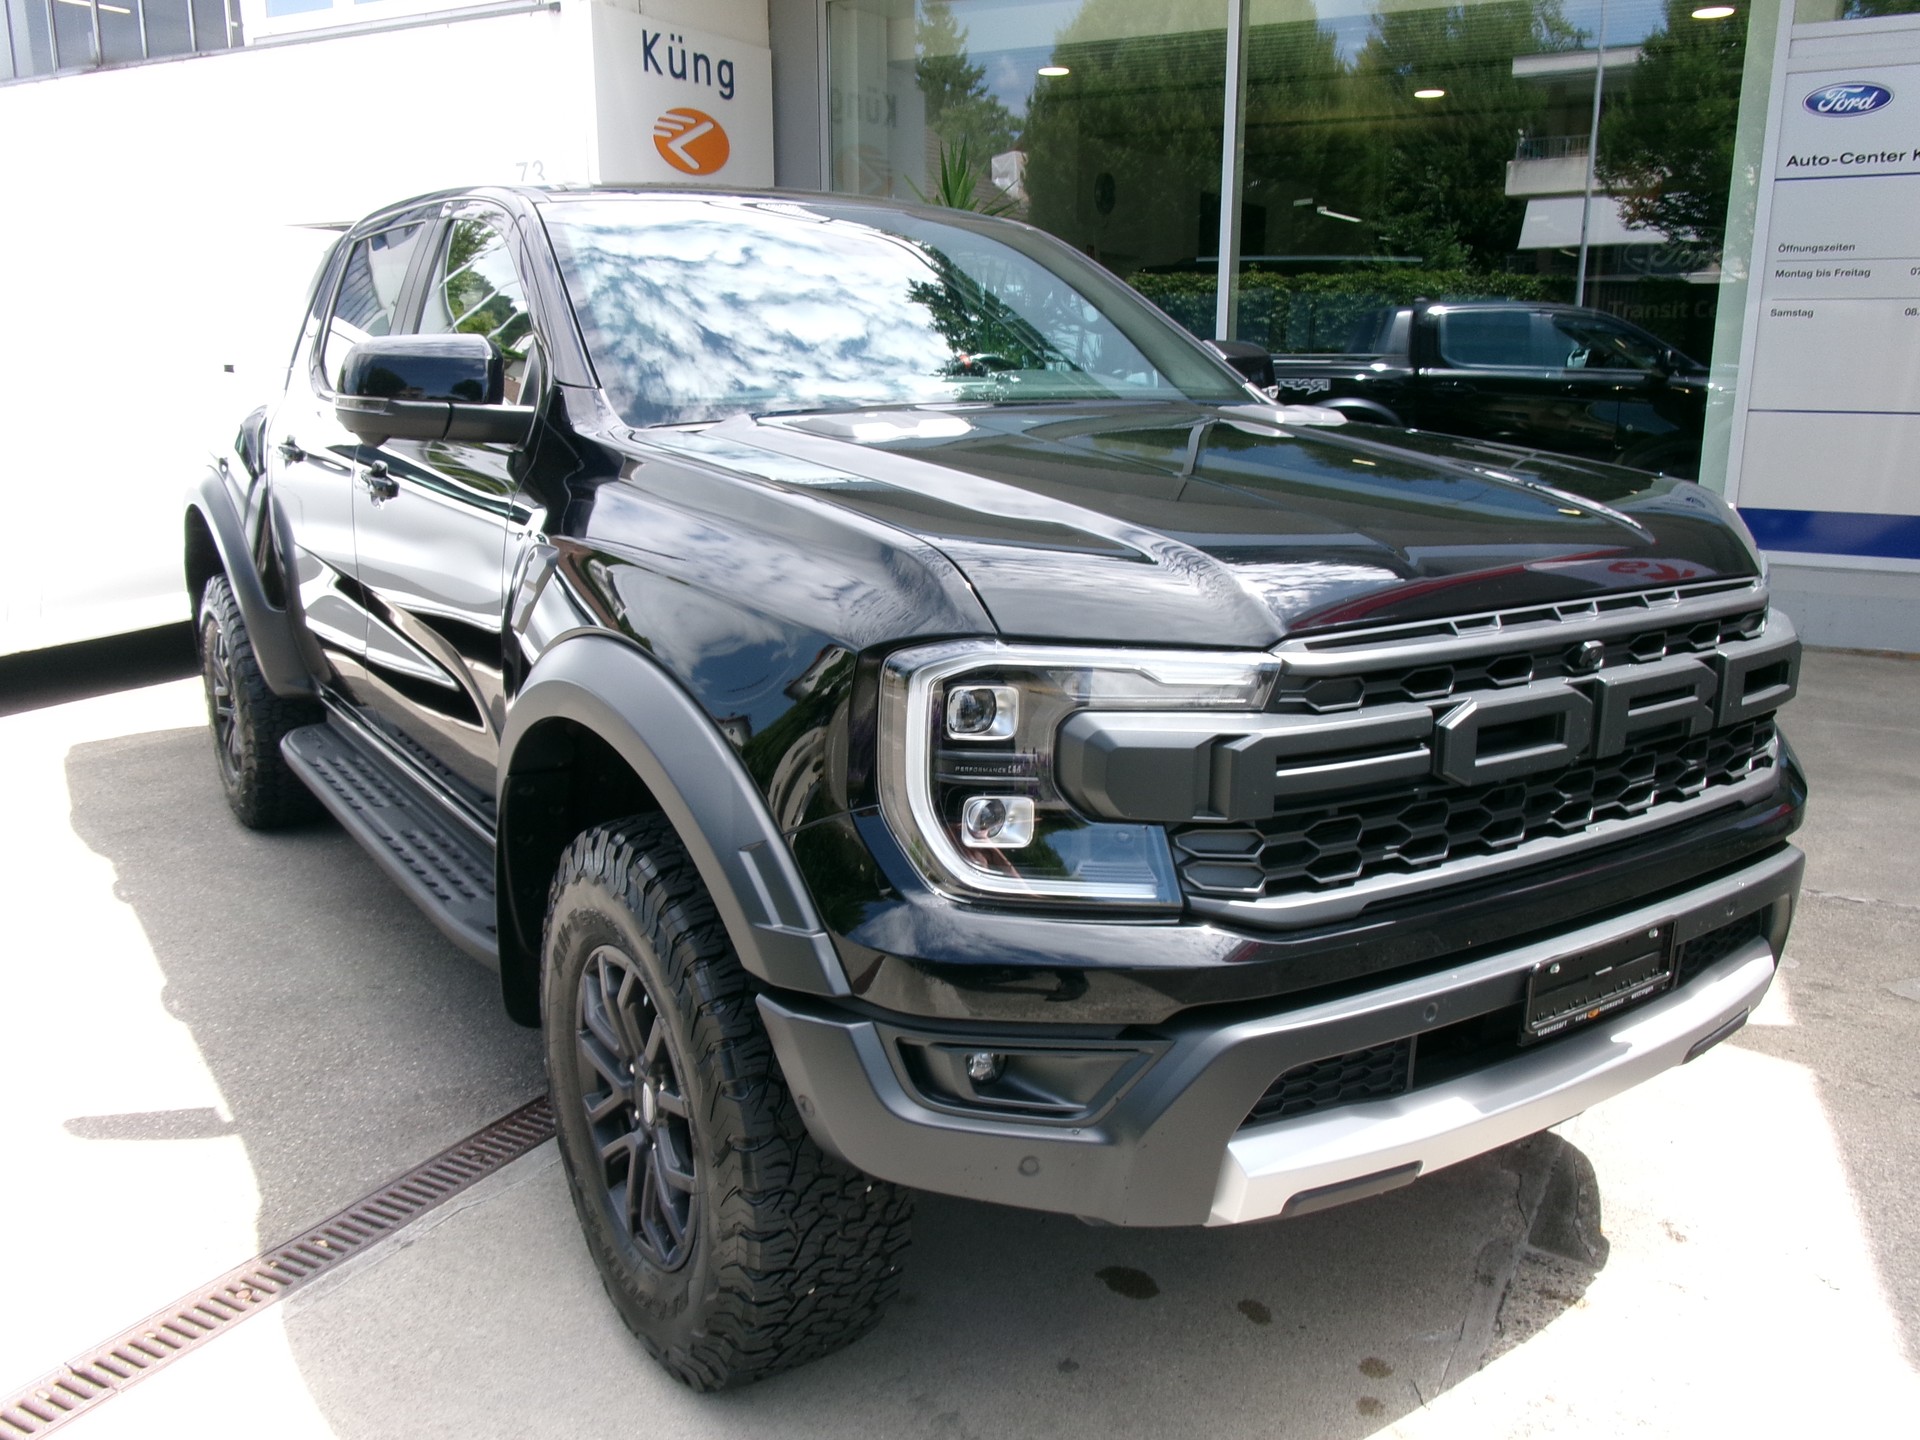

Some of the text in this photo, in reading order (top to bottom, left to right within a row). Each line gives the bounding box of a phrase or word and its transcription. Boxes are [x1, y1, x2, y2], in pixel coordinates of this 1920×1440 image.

[642, 28, 735, 101] Küng
[1815, 85, 1880, 113] Ford
[1785, 150, 1908, 168] Auto-Center
[1777, 242, 1856, 254] Öffnungszeiten
[1774, 268, 1813, 280] Montag
[1815, 268, 1832, 278] bis
[1834, 267, 1871, 279] Freitag
[1608, 299, 1690, 319] Transit
[1770, 307, 1815, 319] Samstag
[1209, 633, 1799, 821] FORD
[954, 764, 1007, 774] PERFORMANCE
